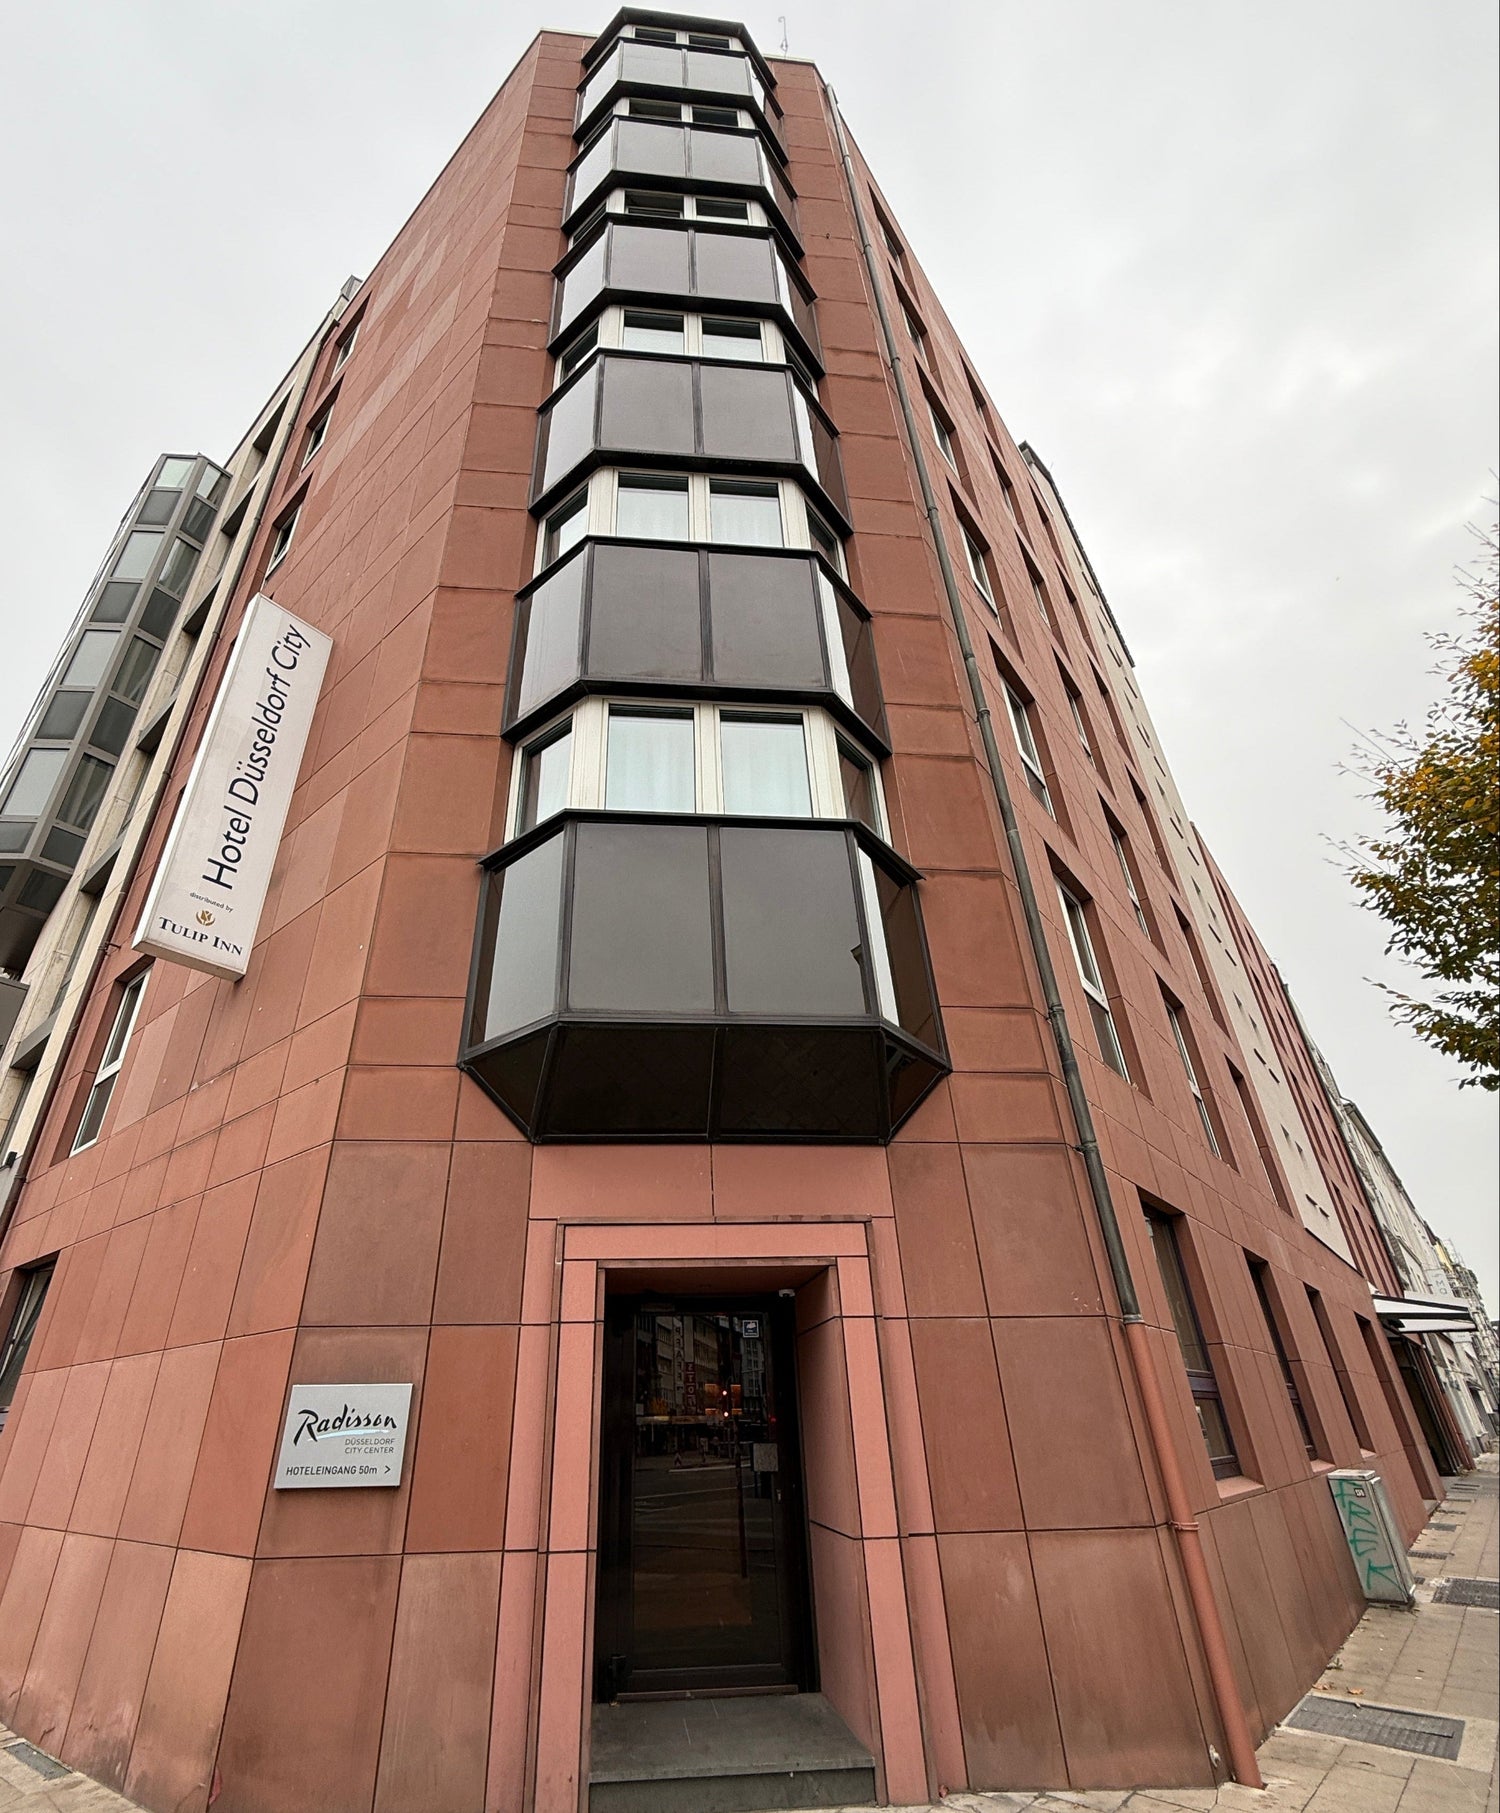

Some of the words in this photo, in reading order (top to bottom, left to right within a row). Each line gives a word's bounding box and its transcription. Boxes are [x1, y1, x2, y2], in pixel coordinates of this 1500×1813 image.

[202, 805, 252, 890] Hotel
[228, 667, 291, 806] Düsseldorf
[271, 624, 311, 670] City
[189, 892, 224, 909] distributed
[225, 905, 234, 913] by
[159, 916, 209, 943] TULIP
[212, 936, 243, 956] INN
[293, 1403, 397, 1447] Radisson
[344, 1437, 396, 1446] DÜSSELDORF
[344, 1447, 363, 1455] CITY
[363, 1446, 395, 1454] CENTER
[286, 1465, 357, 1476] HOTELEINGANG
[358, 1465, 378, 1475] 50m
